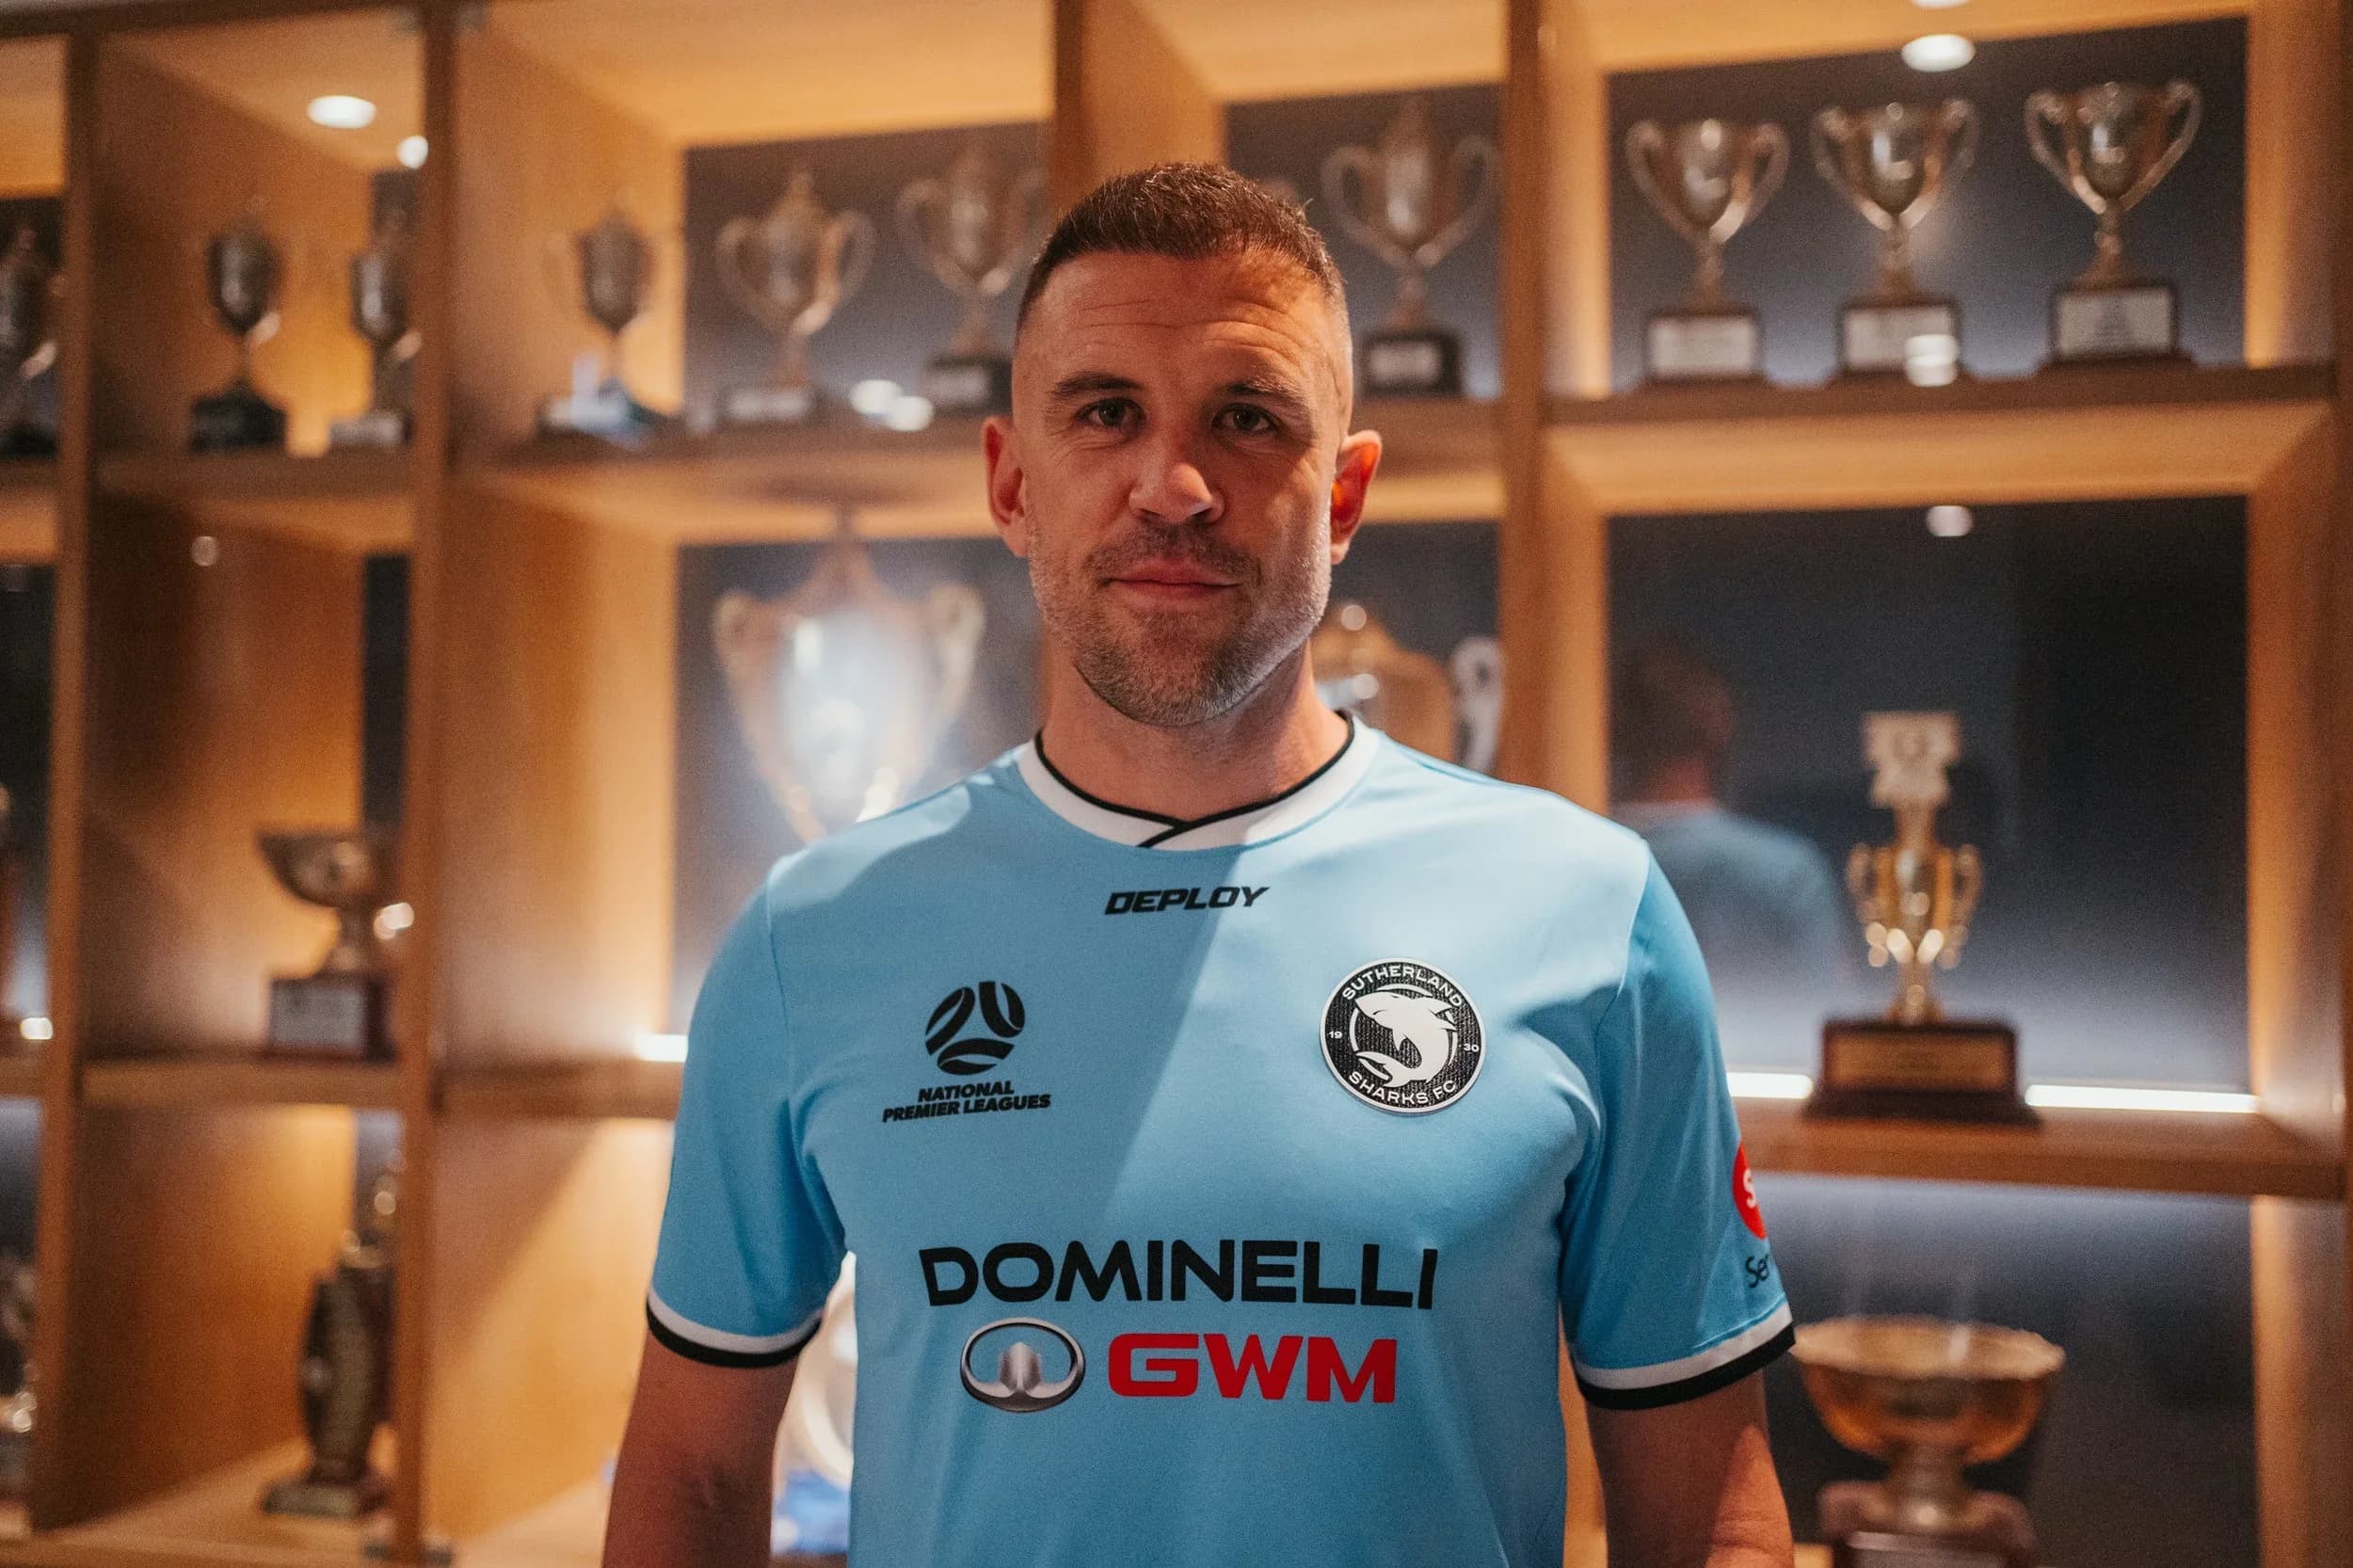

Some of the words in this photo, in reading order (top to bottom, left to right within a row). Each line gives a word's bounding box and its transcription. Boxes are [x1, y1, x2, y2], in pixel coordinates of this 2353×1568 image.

[1104, 887, 1270, 915] DEPLOY
[1343, 966, 1462, 1007] SUTHERLAND
[1329, 1032, 1343, 1040] 19
[1464, 1044, 1481, 1053] 30
[918, 1081, 1015, 1103] NATIONAL
[1350, 1072, 1429, 1105] SHARKS
[1433, 1080, 1456, 1100] FC
[883, 1102, 960, 1123] PREMIER
[964, 1094, 1051, 1114] LEAGUES
[919, 1240, 1438, 1310] DOMINELLI
[1745, 1255, 1769, 1288] Se
[1109, 1333, 1397, 1402] GWM
